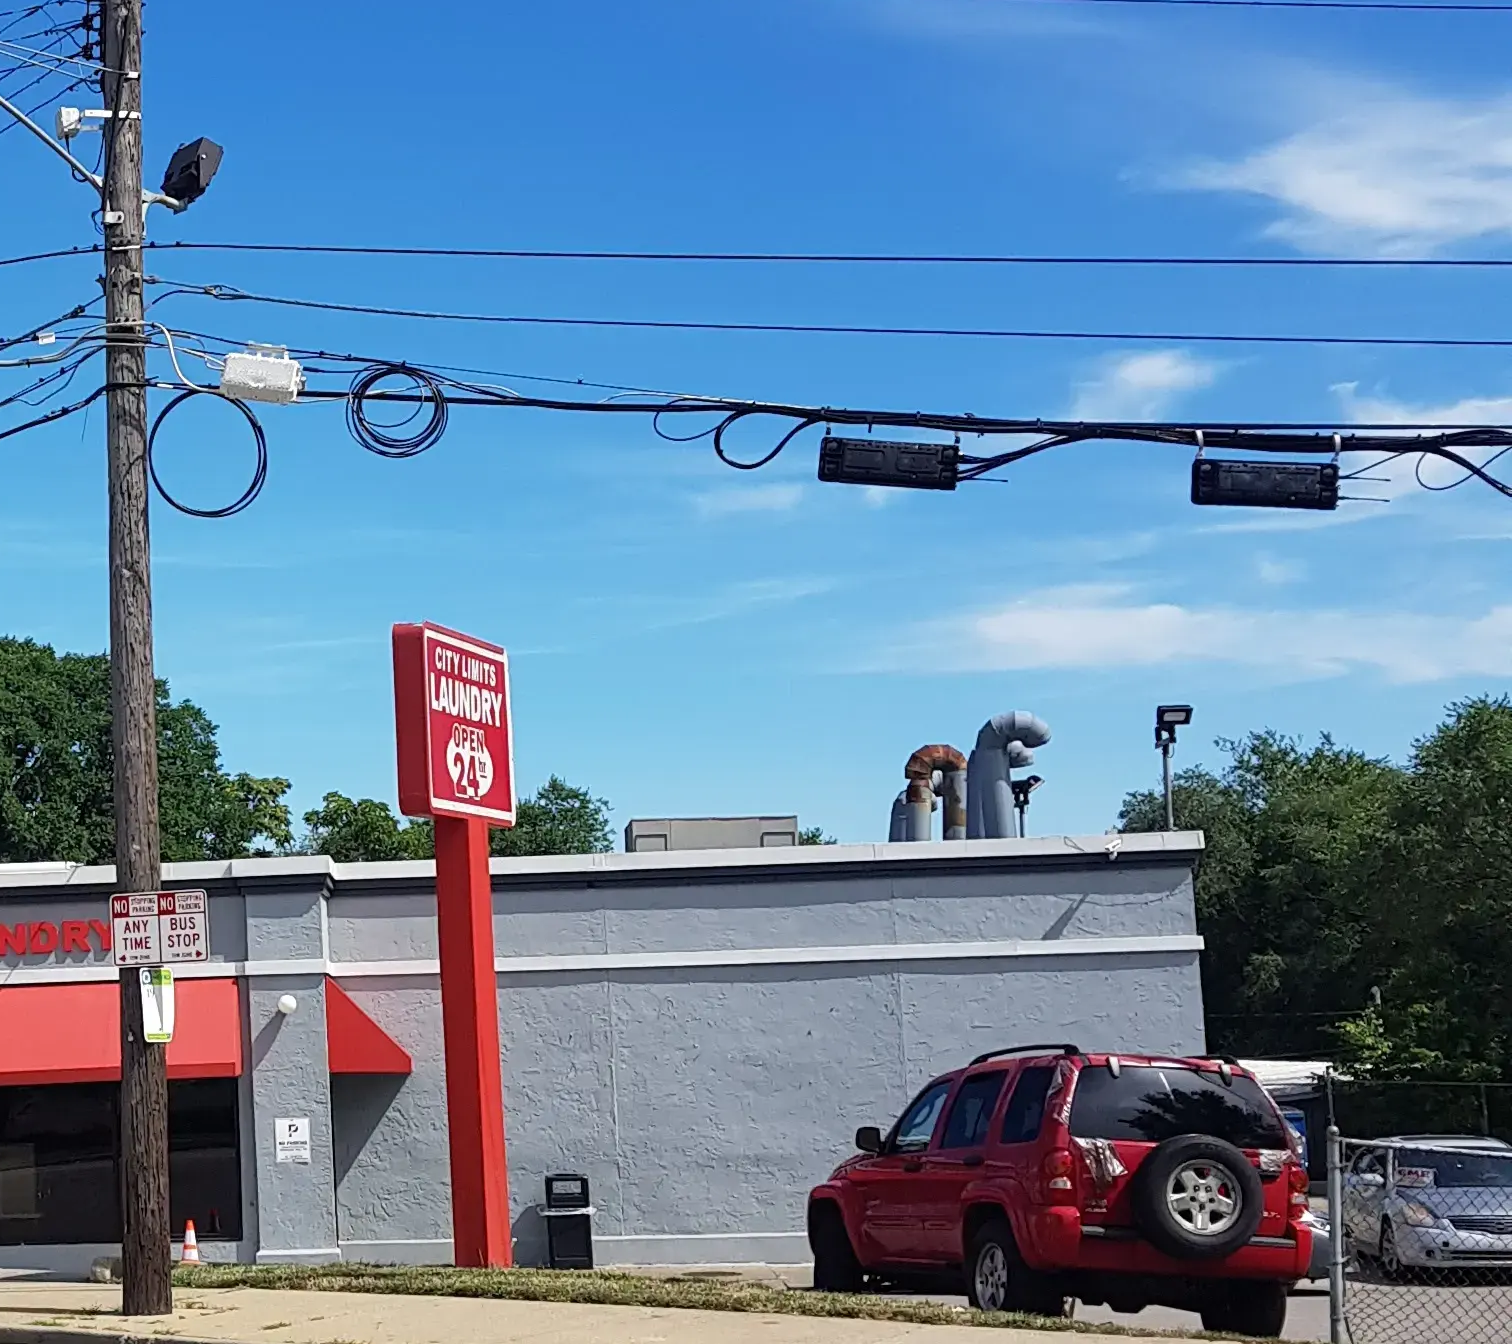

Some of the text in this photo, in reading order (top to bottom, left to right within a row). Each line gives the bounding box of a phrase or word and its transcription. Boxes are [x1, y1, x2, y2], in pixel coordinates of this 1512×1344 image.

[435, 646, 496, 686] CITY LIMITS
[430, 672, 502, 728] LAUNDRY
[454, 726, 484, 754] OPEN
[114, 900, 127, 914] NO
[160, 897, 174, 911] NO
[124, 920, 148, 934] ANY
[170, 917, 196, 930] BUS
[122, 936, 151, 950] TIME
[168, 933, 200, 947] STOP
